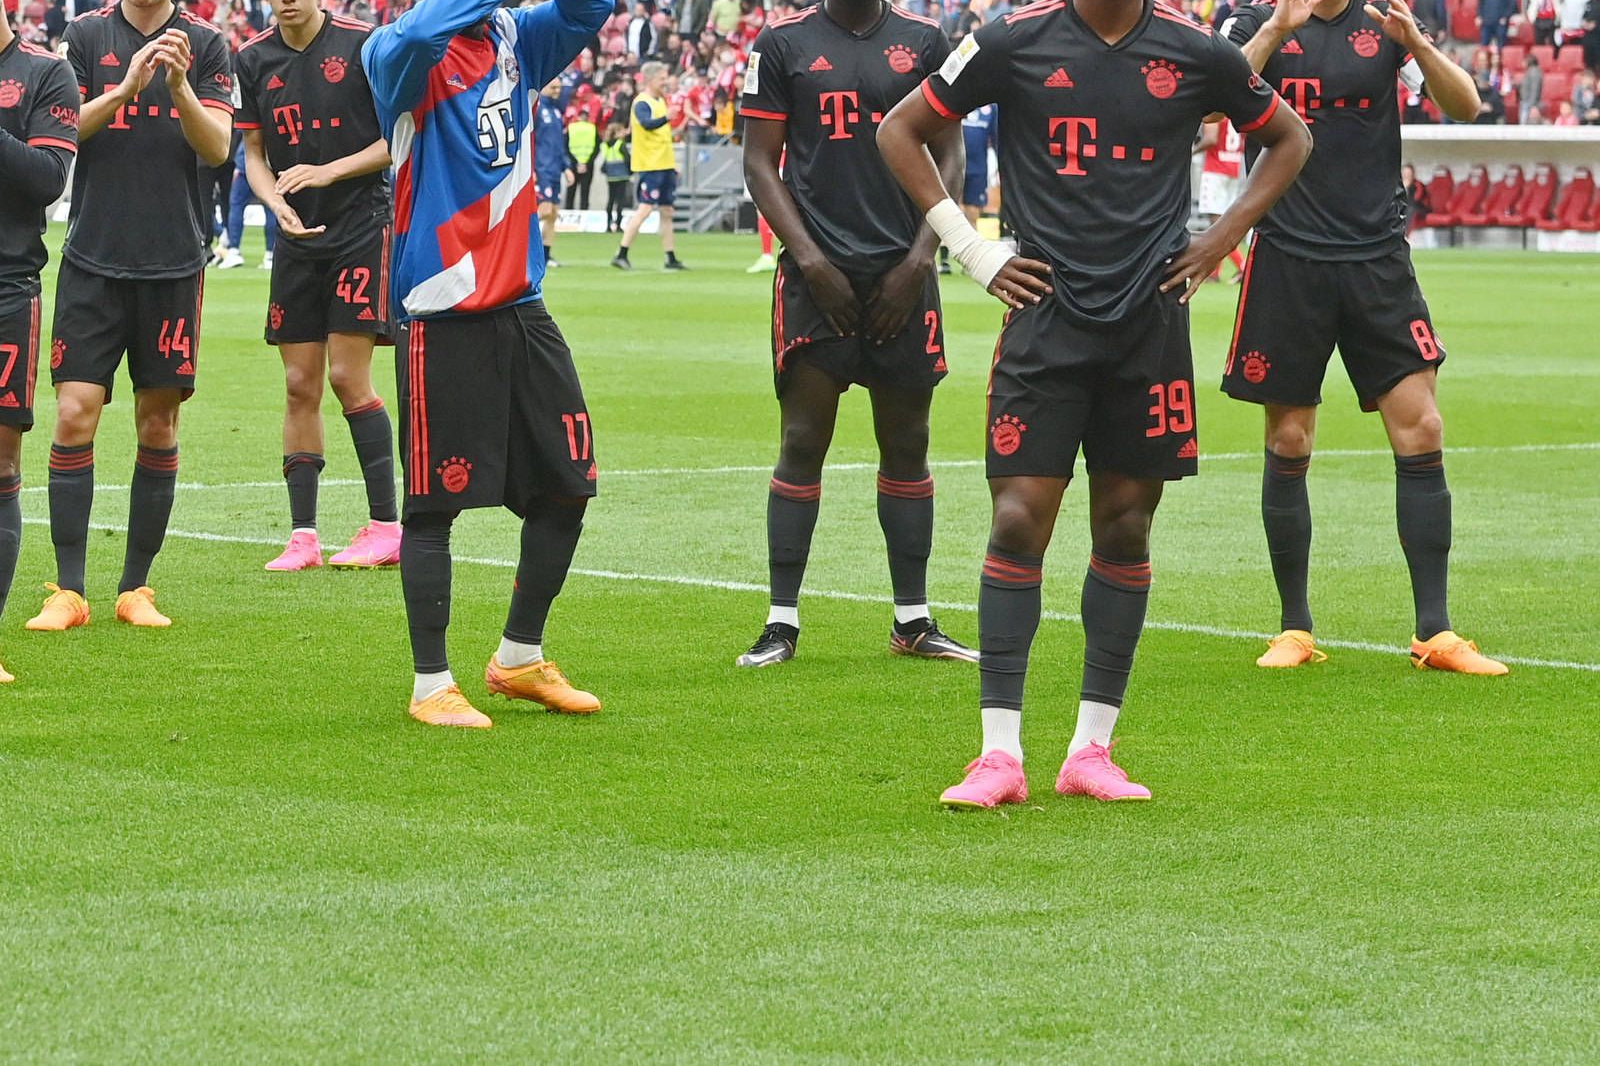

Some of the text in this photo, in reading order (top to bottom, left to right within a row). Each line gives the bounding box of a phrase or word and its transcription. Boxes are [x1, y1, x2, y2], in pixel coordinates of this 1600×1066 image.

[336, 267, 370, 304] 42
[158, 318, 191, 359] 44
[924, 310, 941, 354] 2
[1410, 319, 1438, 361] 8
[1146, 379, 1193, 438] 39
[561, 412, 590, 461] 17
